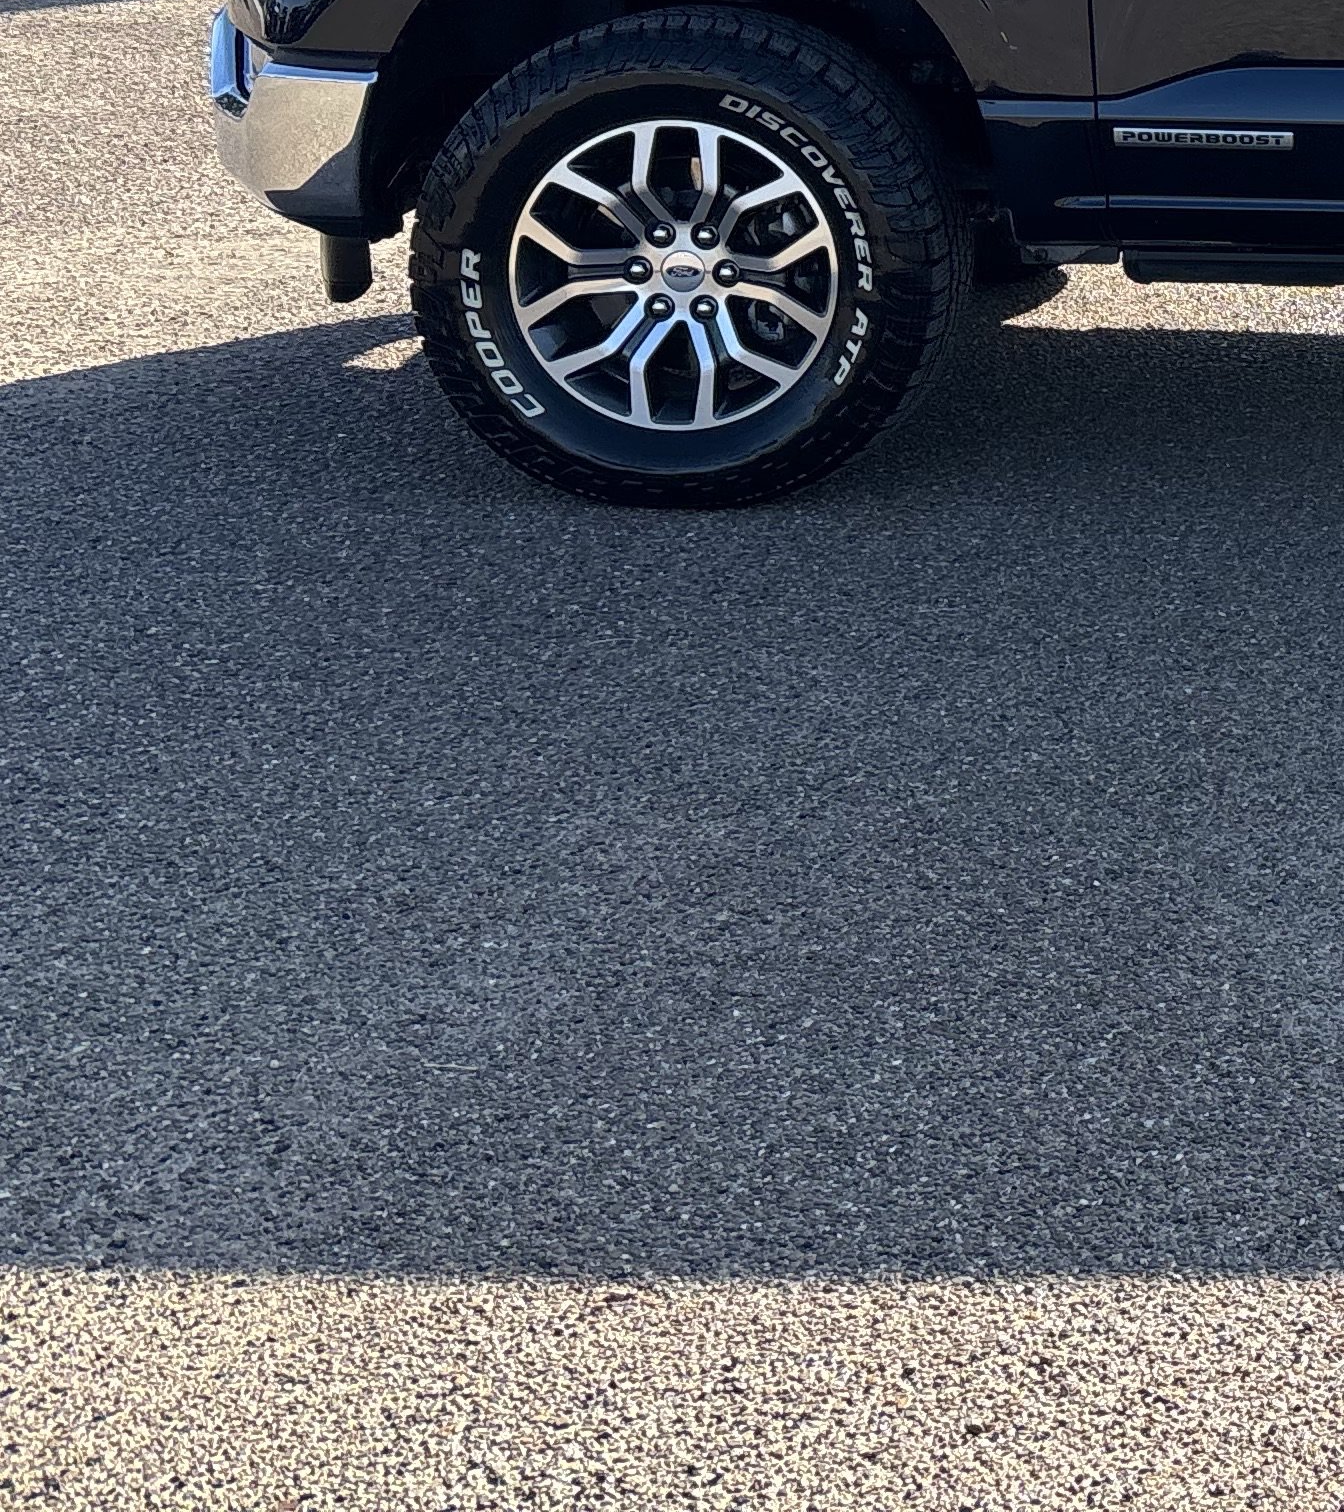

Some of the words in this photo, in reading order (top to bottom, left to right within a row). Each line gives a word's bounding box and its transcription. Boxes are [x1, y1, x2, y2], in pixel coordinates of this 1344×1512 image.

[1122, 131, 1284, 146] POWERBOOST
[719, 93, 873, 291] DISCOVERER
[832, 309, 868, 386] ATP
[460, 248, 545, 419] COOPER
